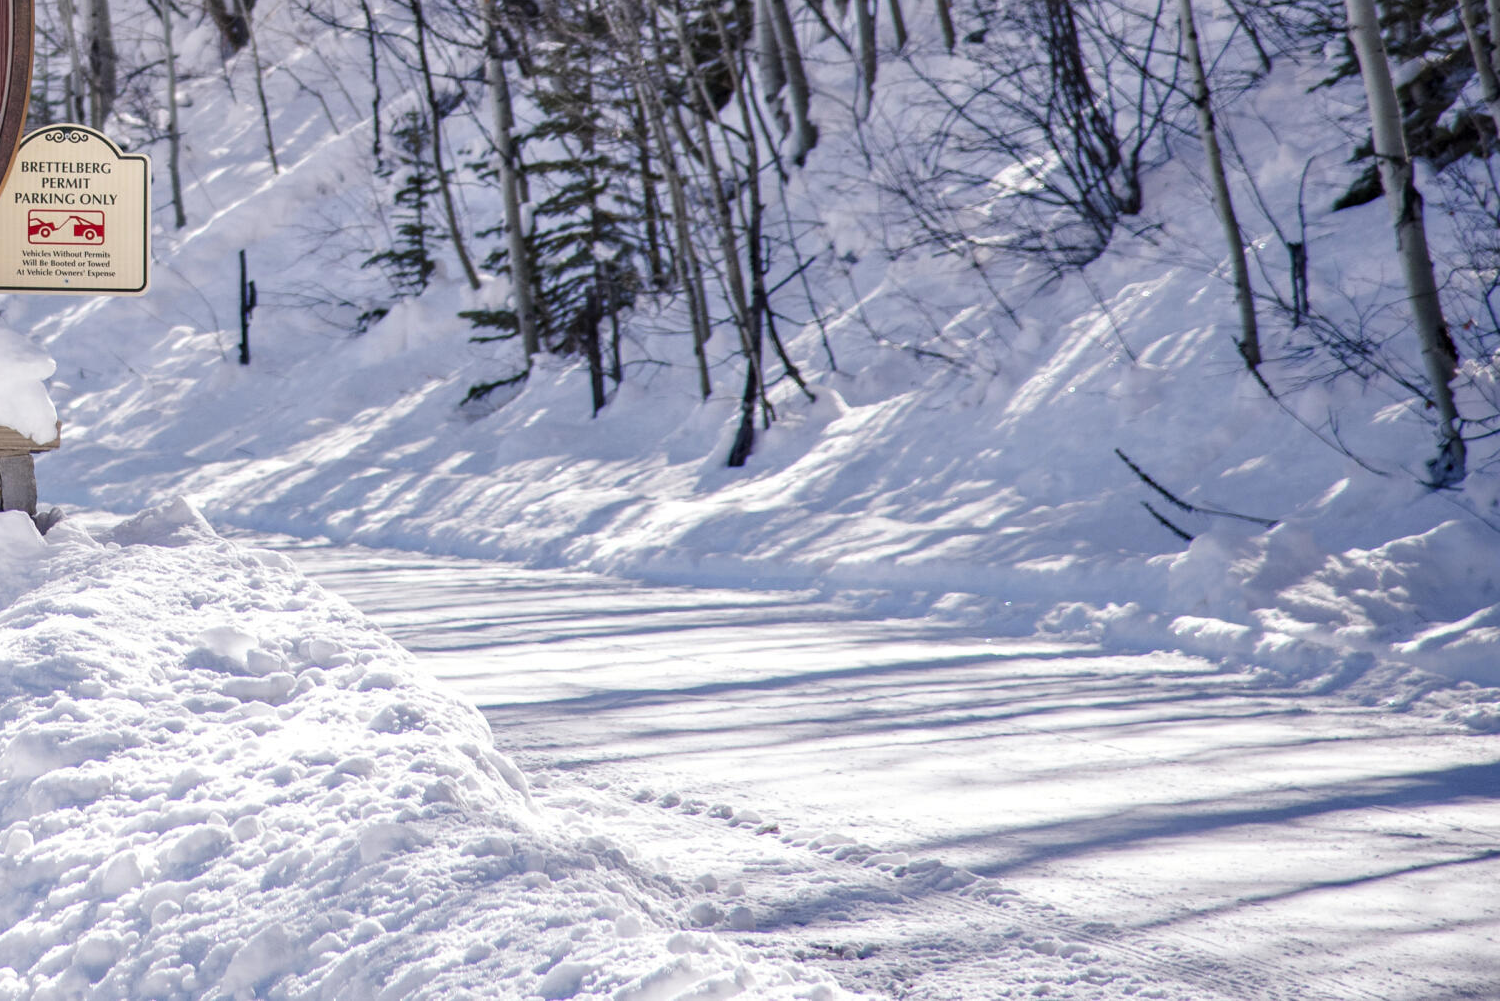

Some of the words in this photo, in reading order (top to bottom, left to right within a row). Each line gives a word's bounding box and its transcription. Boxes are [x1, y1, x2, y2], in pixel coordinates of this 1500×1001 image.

[21, 161, 112, 174] BRETTELBERG
[41, 177, 91, 189] PERMIT
[14, 192, 75, 205] PARKING
[79, 193, 118, 205] ONLY
[22, 250, 51, 258] Vehicles
[52, 250, 82, 258] Without
[22, 259, 38, 267] Will
[87, 260, 110, 268] Towed
[87, 270, 116, 278] Expense
